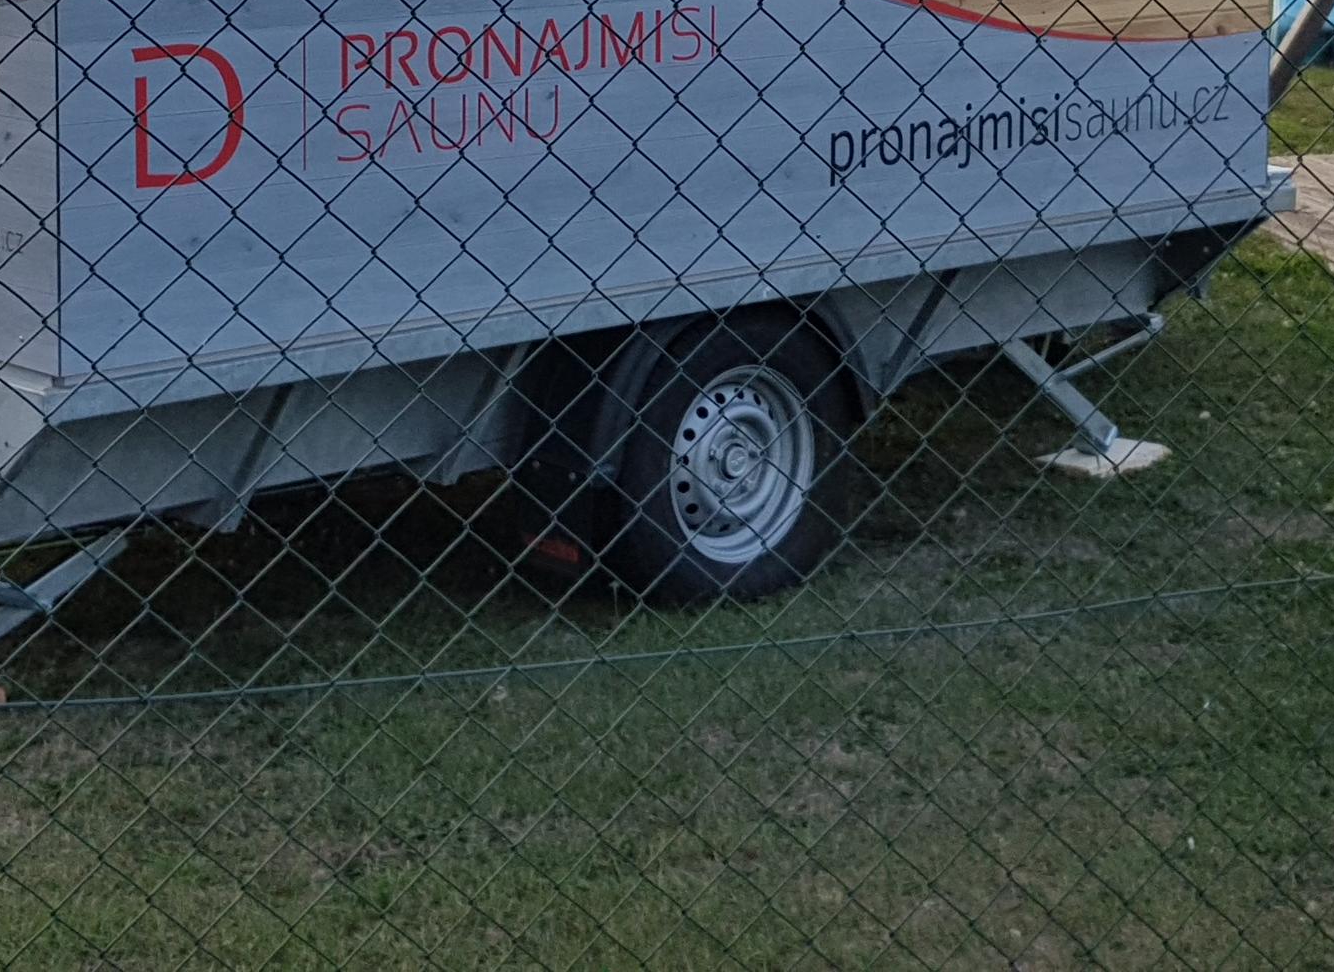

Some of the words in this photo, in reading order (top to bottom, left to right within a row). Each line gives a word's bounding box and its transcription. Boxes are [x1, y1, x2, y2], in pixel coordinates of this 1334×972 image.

[339, 5, 717, 92] PRONAJMISI
[131, 43, 244, 189] D
[336, 84, 560, 162] SAUNU
[829, 84, 1230, 186] pronajmisisaunu.cz
